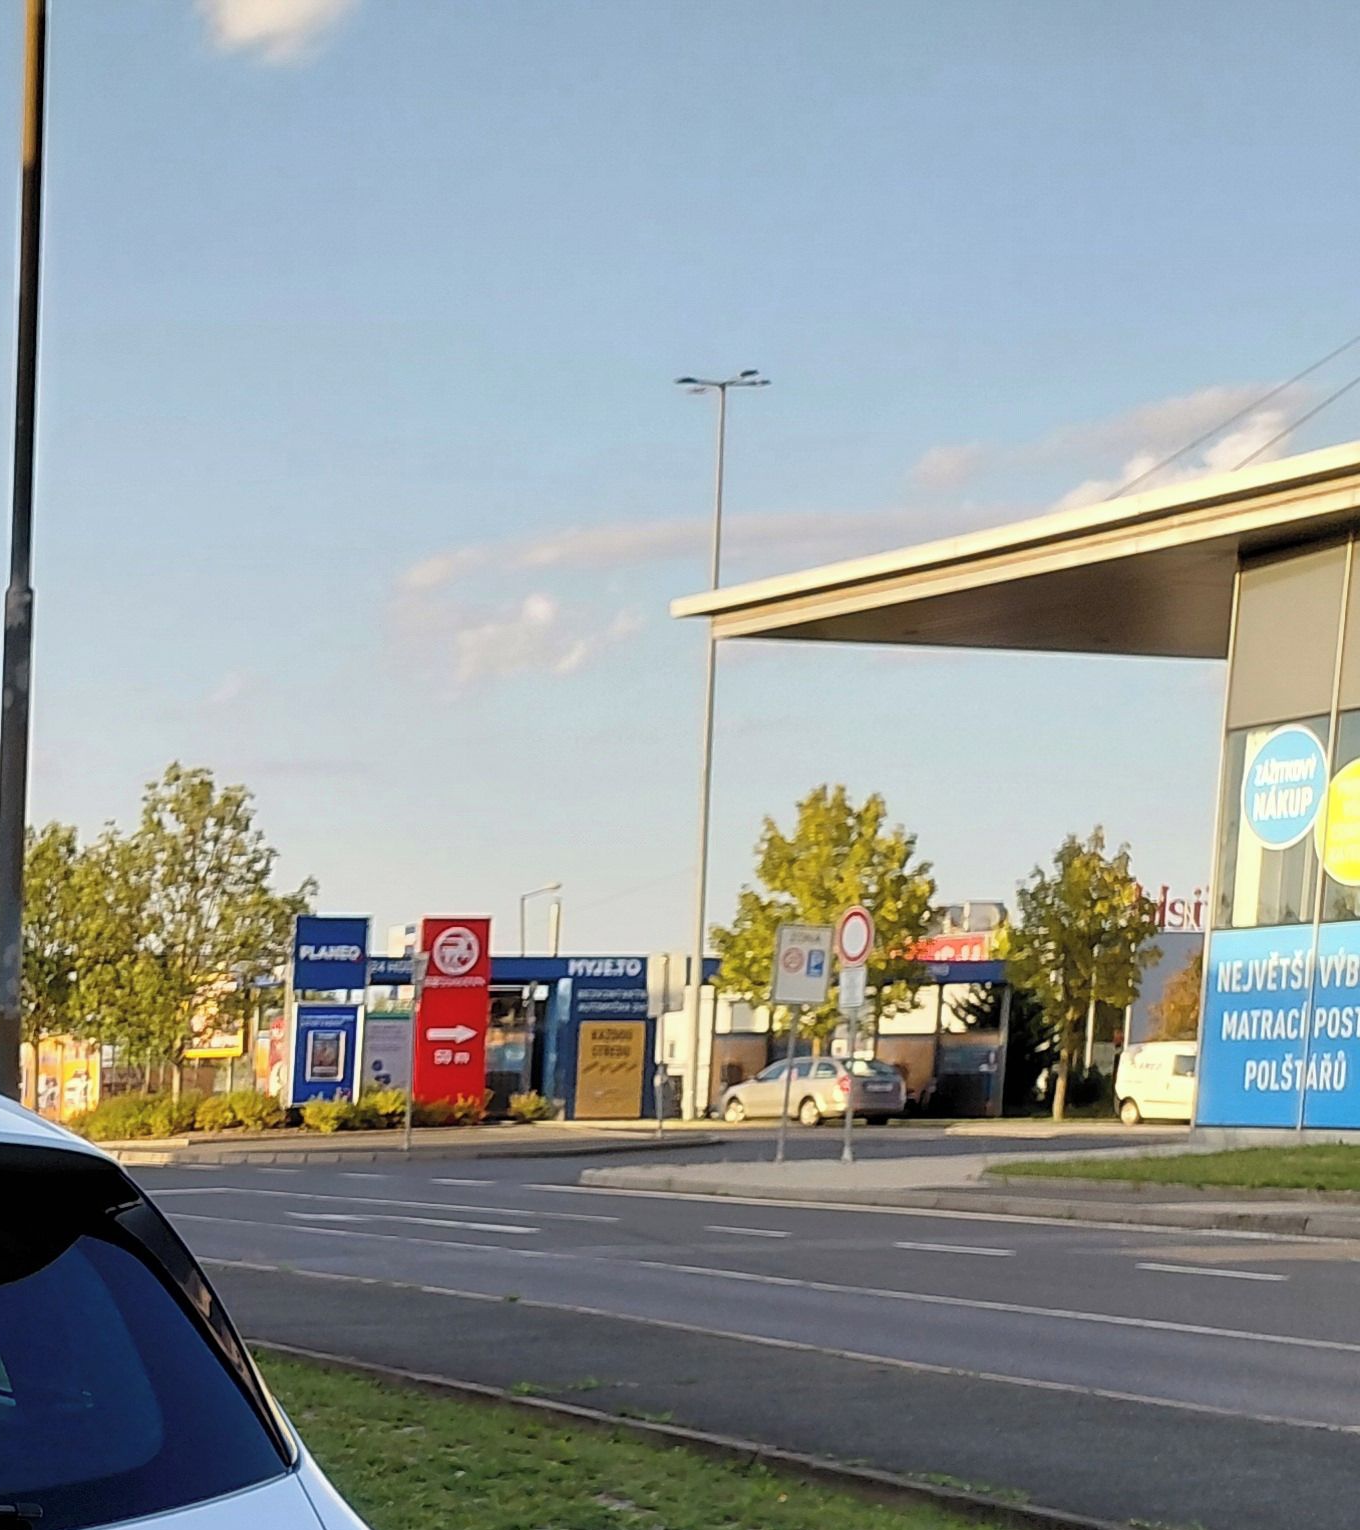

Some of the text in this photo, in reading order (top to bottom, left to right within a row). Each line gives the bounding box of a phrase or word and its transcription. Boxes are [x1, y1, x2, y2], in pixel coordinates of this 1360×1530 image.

[1252, 784, 1313, 822] NÁKUP
[1216, 949, 1315, 993] NEJVĚTŠÍ
[1221, 1000, 1308, 1041] MATRACÍ
[1244, 1050, 1347, 1092] POLŠTÁŘŮ
